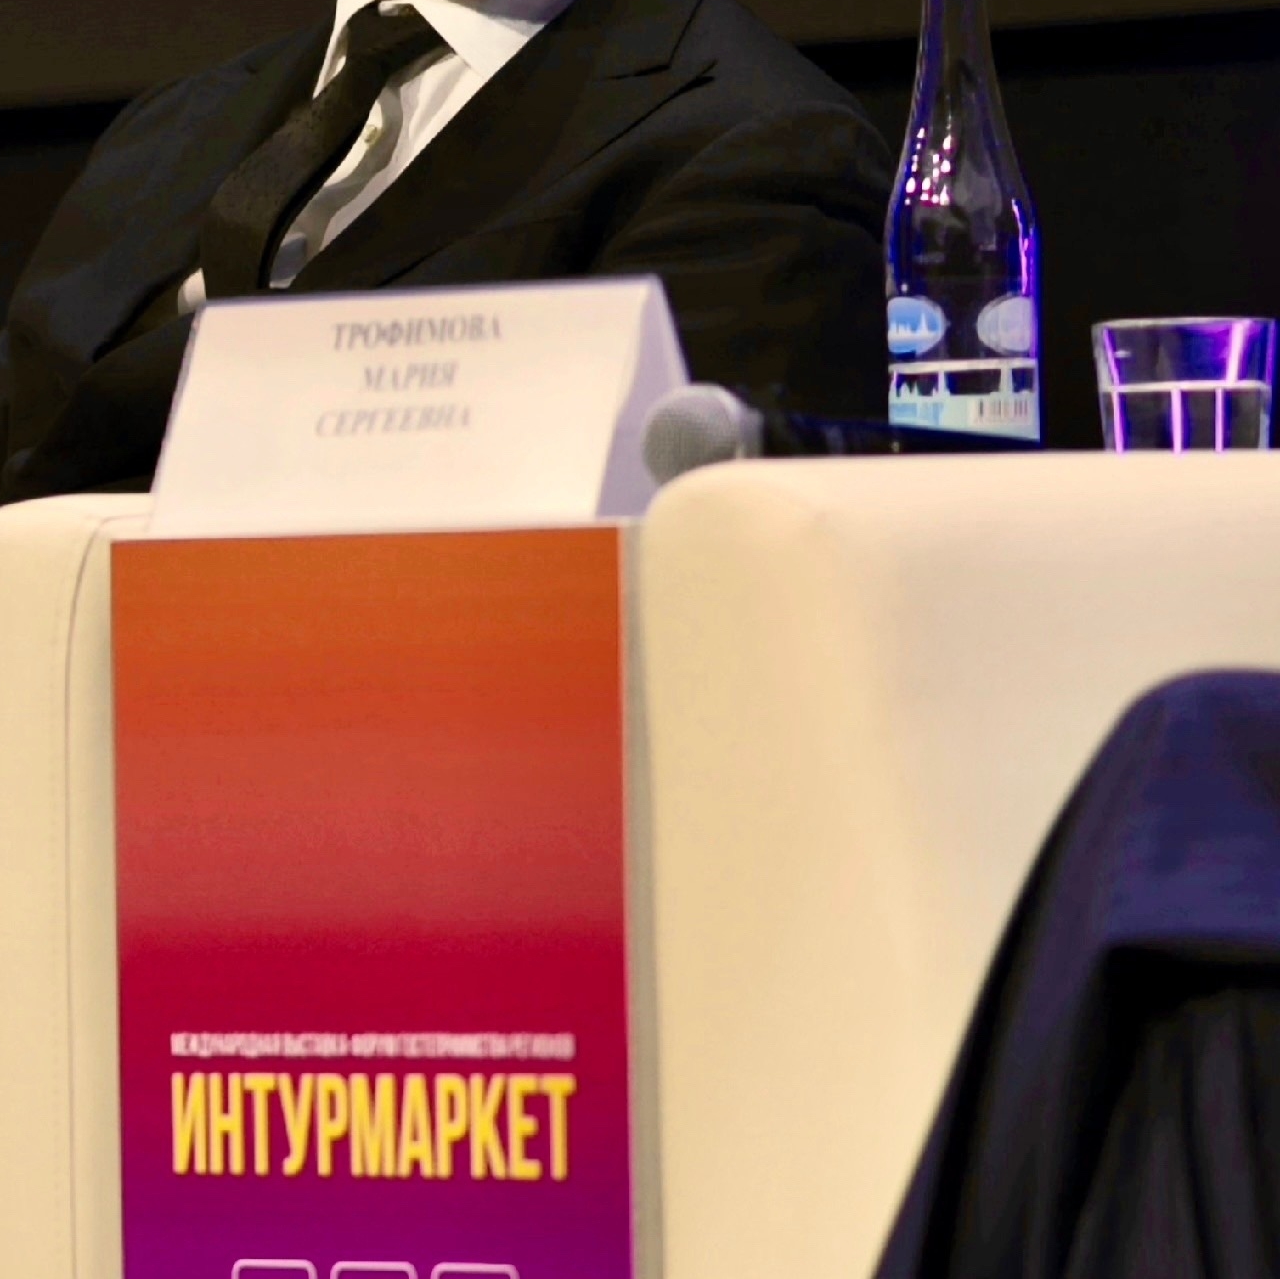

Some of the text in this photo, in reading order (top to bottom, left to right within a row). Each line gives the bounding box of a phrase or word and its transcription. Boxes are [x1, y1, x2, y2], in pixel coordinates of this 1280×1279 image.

[331, 313, 503, 352] ТРОФИМОВА
[361, 360, 460, 392] МАРИЯ
[314, 404, 474, 437] СЕРГЕЕВНА
[170, 1072, 577, 1181] ИНТУРМАРКЕТ
